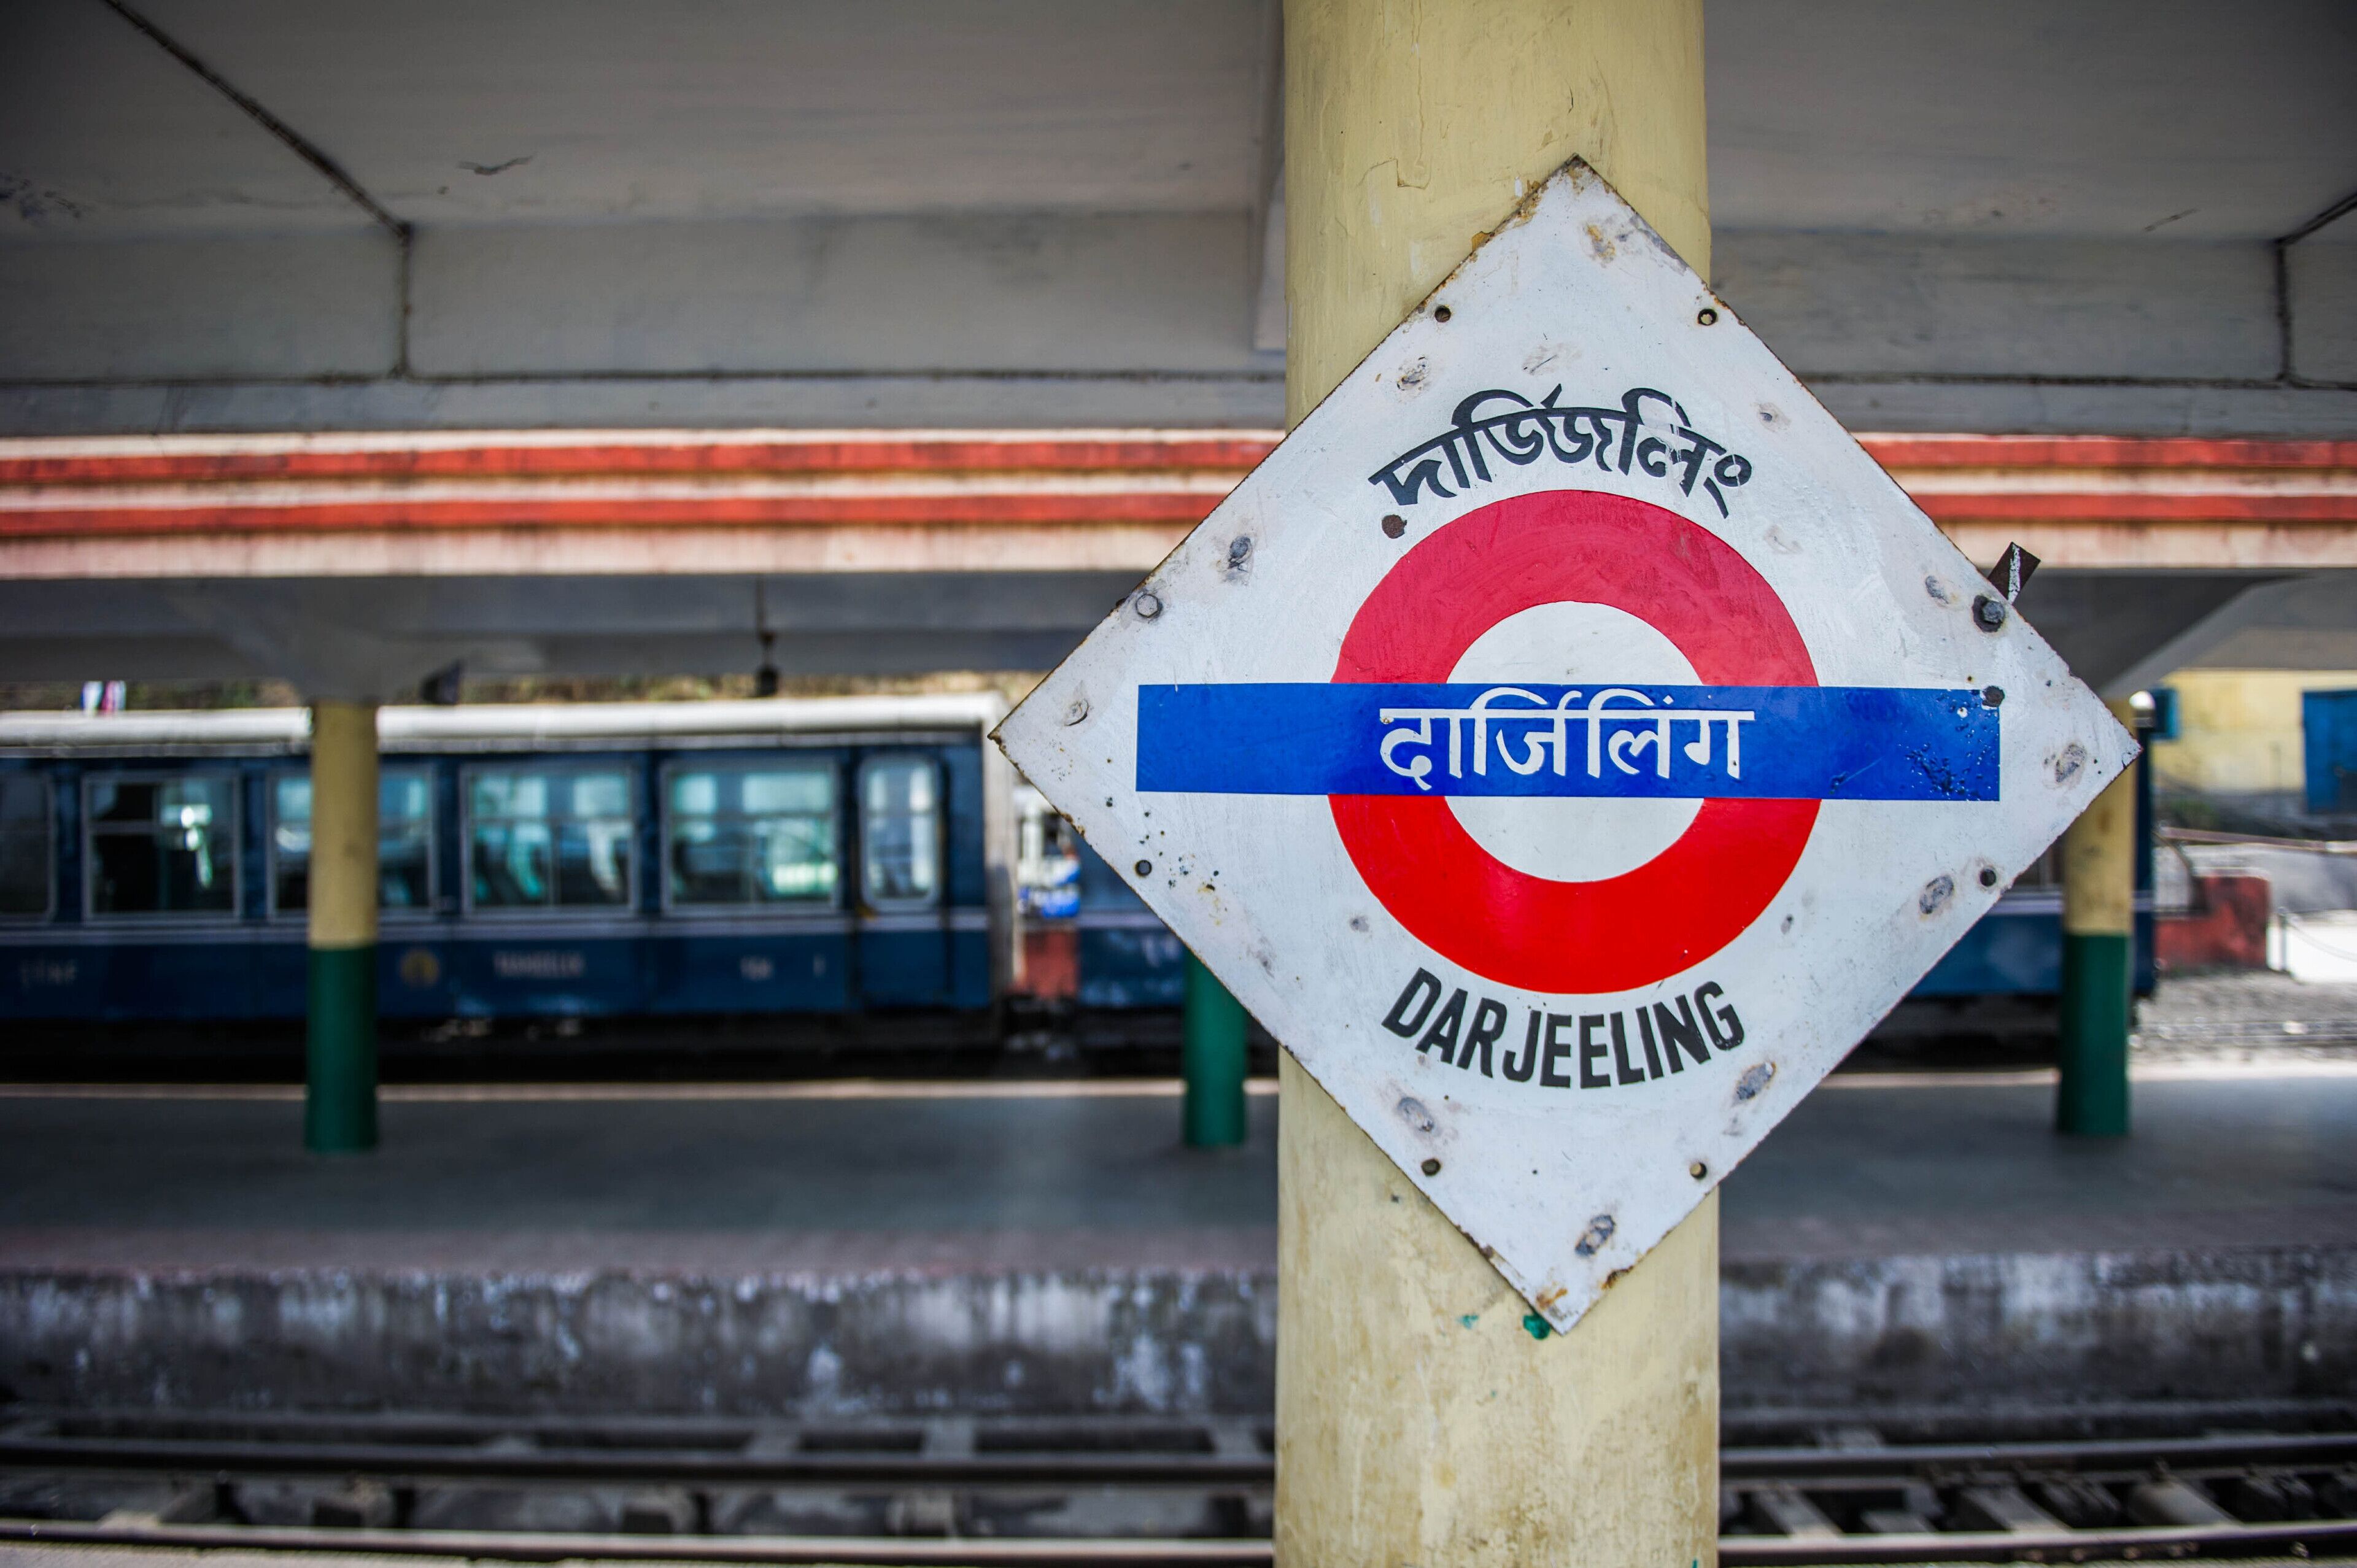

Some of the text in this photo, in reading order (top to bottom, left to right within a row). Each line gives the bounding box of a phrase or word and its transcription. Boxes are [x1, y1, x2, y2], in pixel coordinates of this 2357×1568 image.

[1368, 383, 1752, 519] দার্জিলিং
[1379, 687, 1755, 790] दार्जिलिंग
[1381, 967, 1744, 1089] DARJEELING
